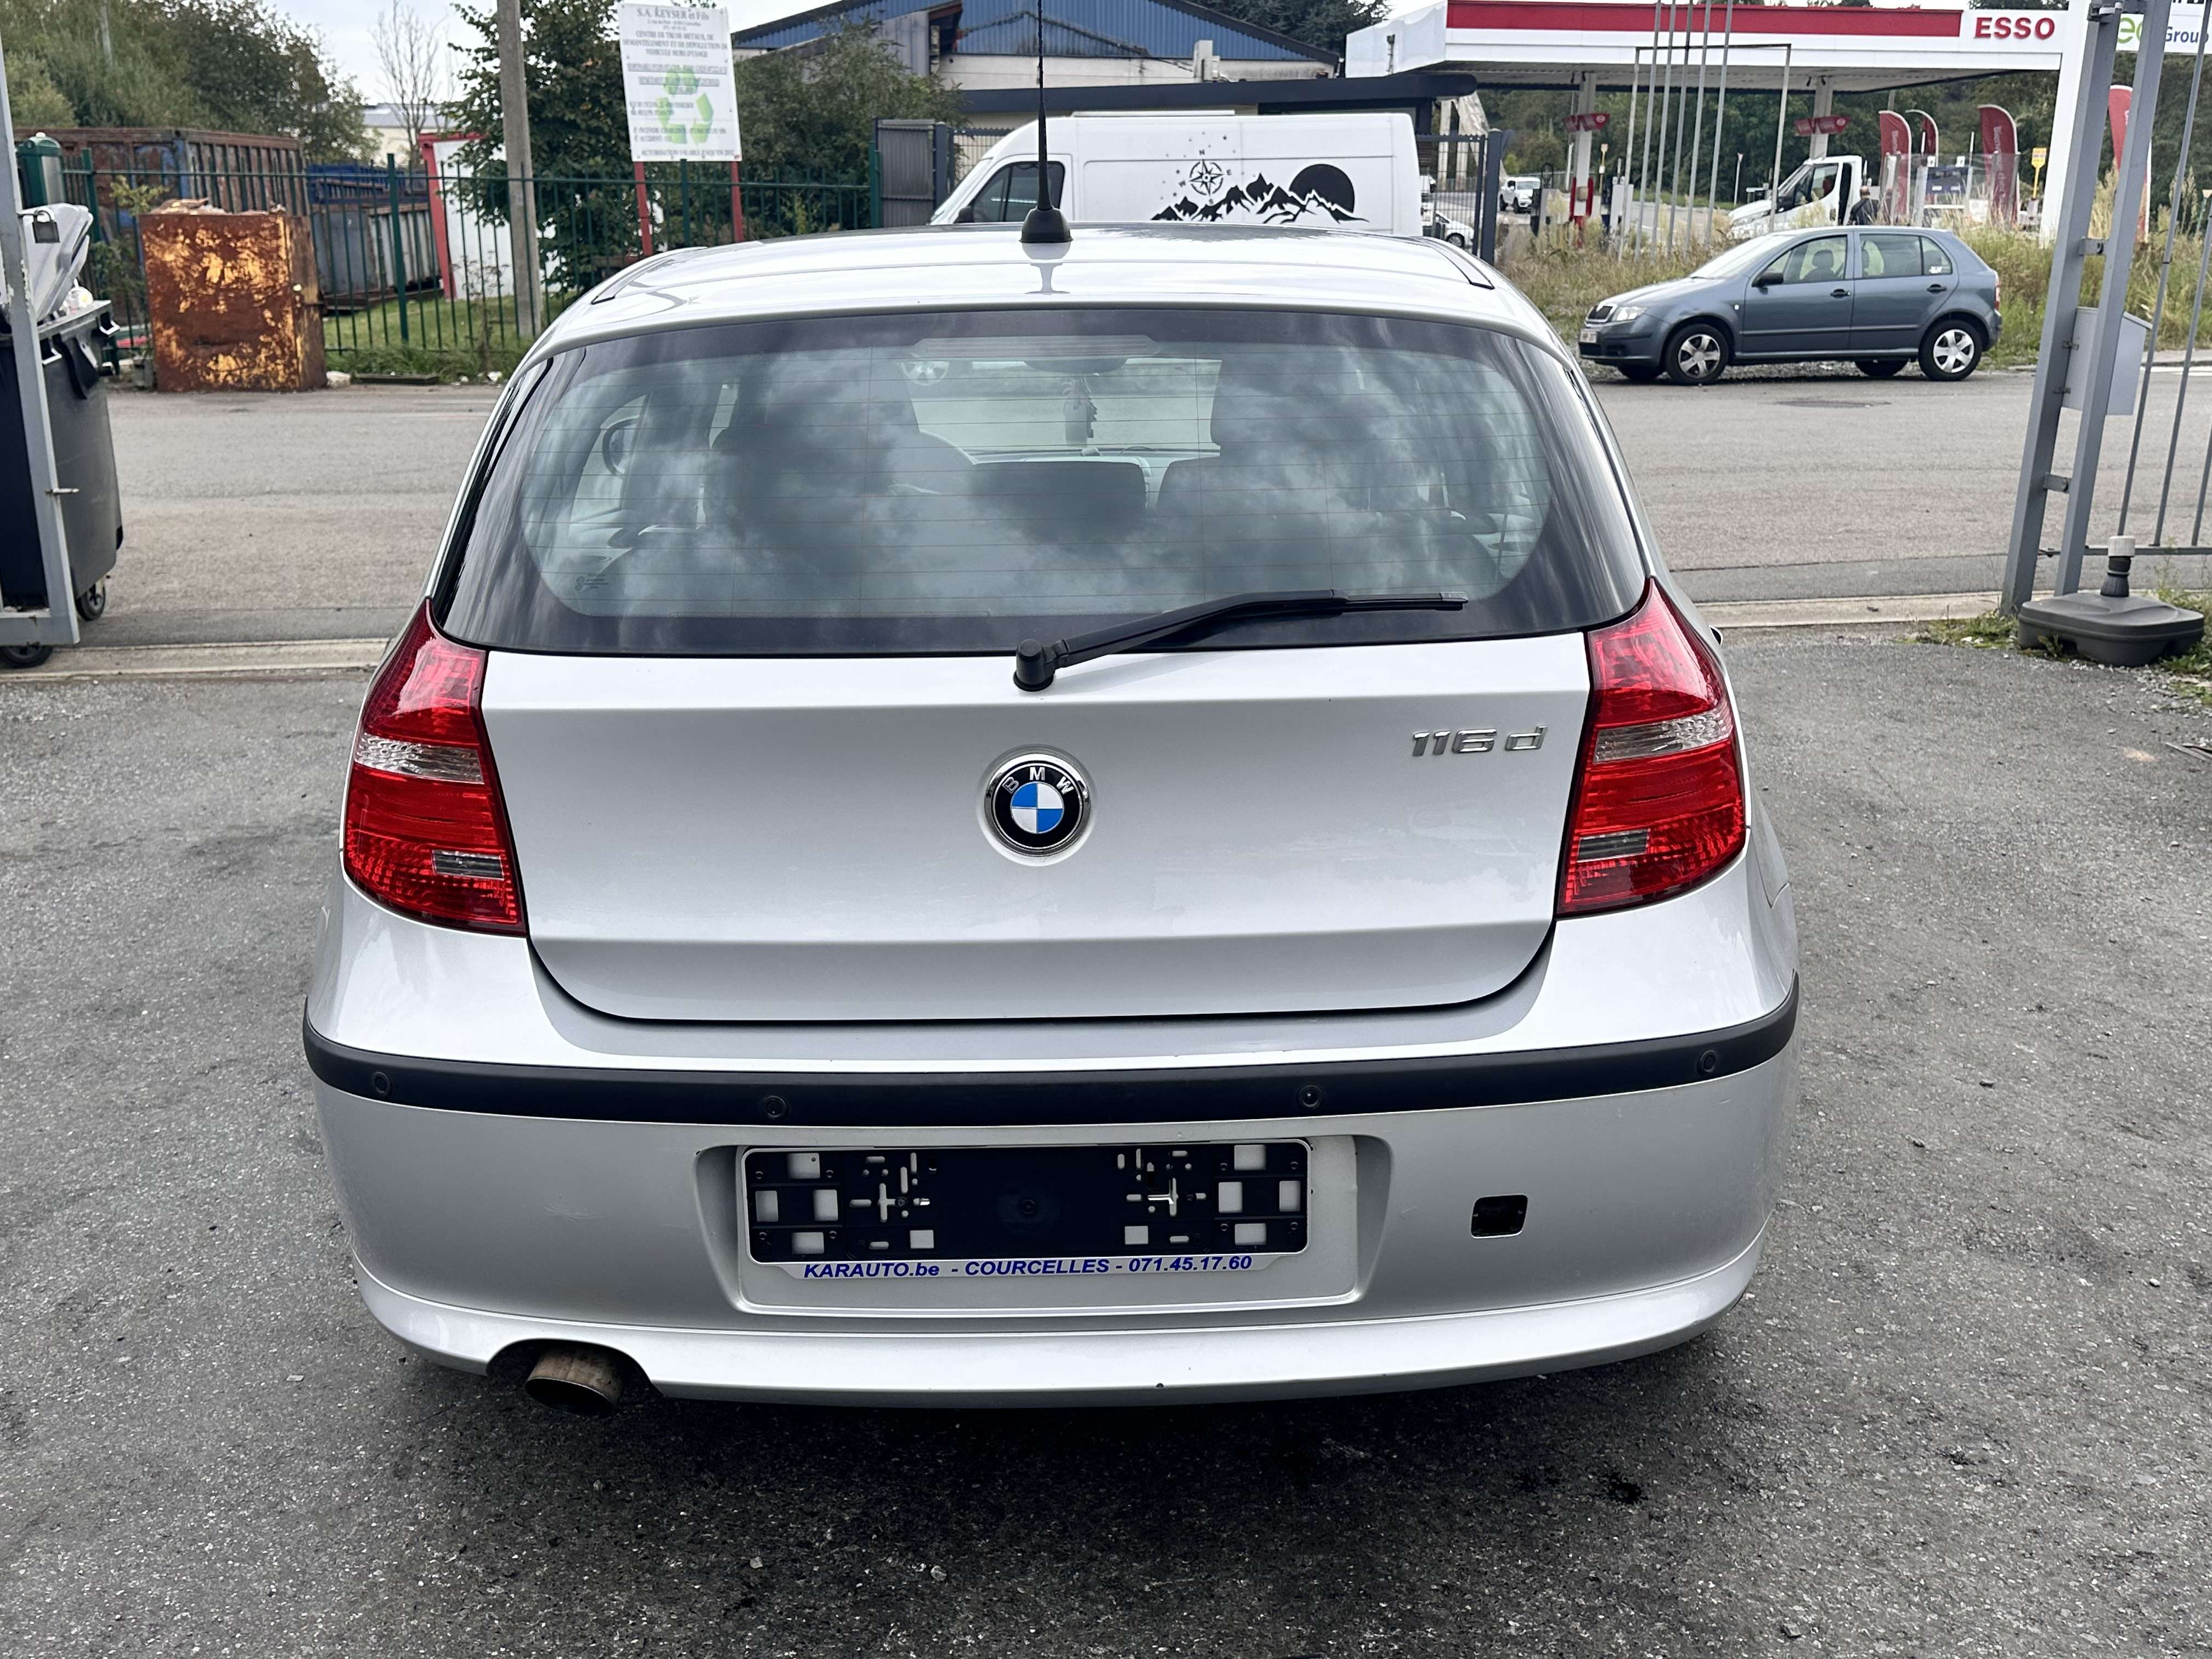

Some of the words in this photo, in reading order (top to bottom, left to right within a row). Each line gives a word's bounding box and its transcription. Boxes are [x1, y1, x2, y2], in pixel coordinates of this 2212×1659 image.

[654, 9, 687, 19] KEYSER
[1975, 16, 2055, 40] ESSO
[1002, 766, 1074, 795] BMW
[804, 1262, 940, 1278] KARAUTO.be
[965, 1259, 1110, 1276] COURCELLES
[1128, 1255, 1252, 1272] 071.45.17.60
